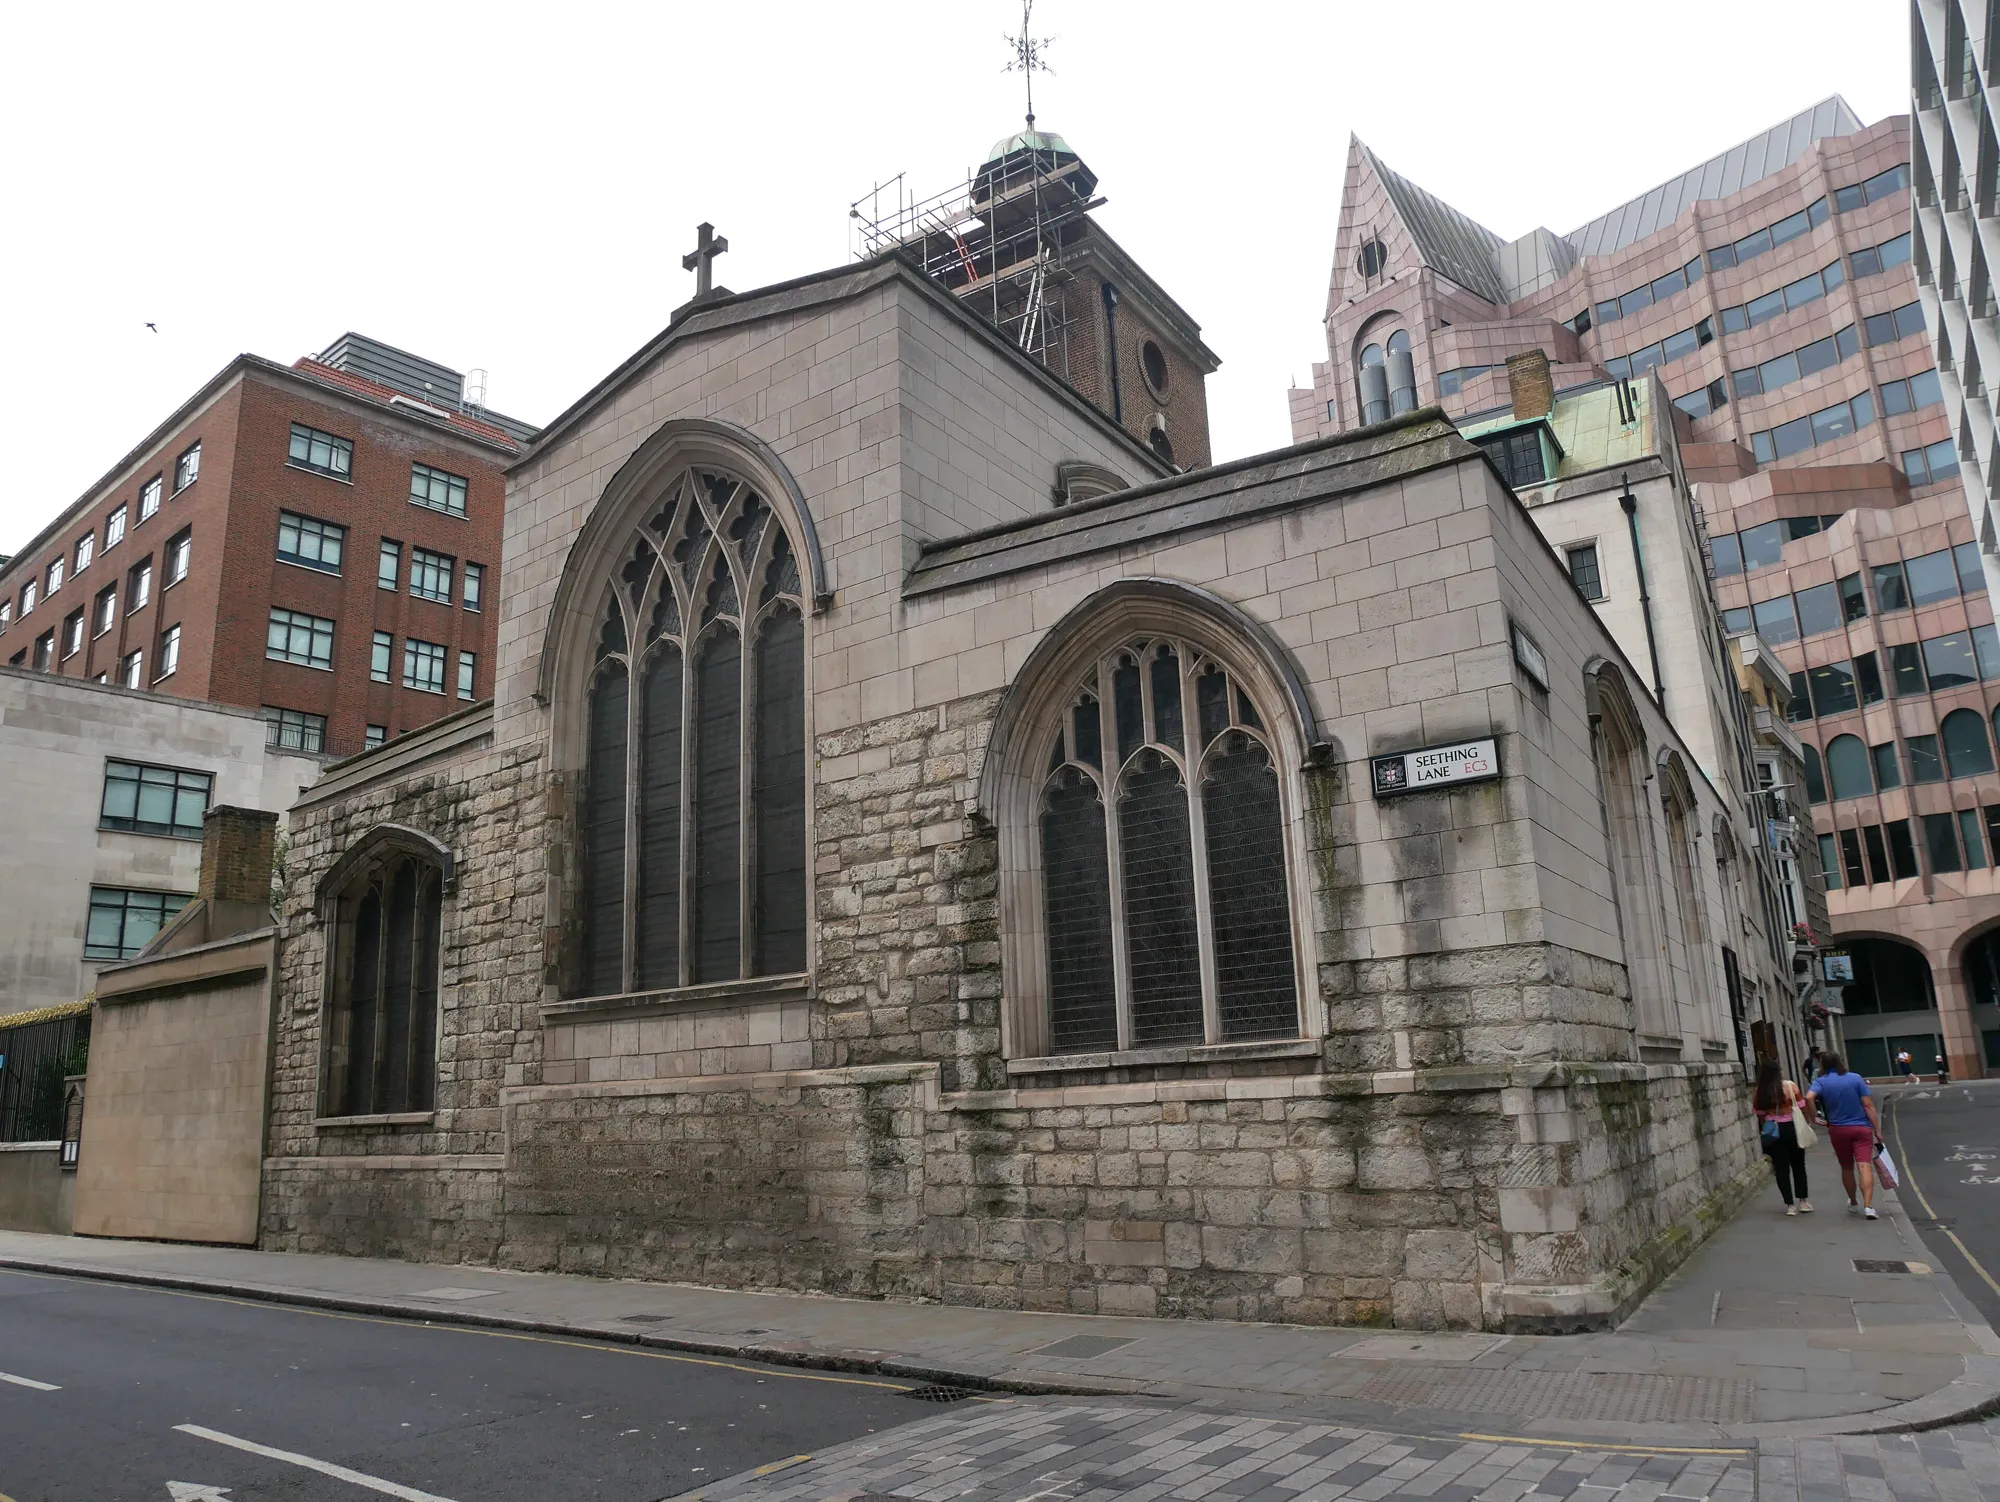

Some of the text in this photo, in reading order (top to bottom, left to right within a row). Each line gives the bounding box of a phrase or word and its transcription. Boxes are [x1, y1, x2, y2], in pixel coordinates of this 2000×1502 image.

[1416, 747, 1478, 767] SEETHING
[1417, 760, 1488, 781] LANE EC3
